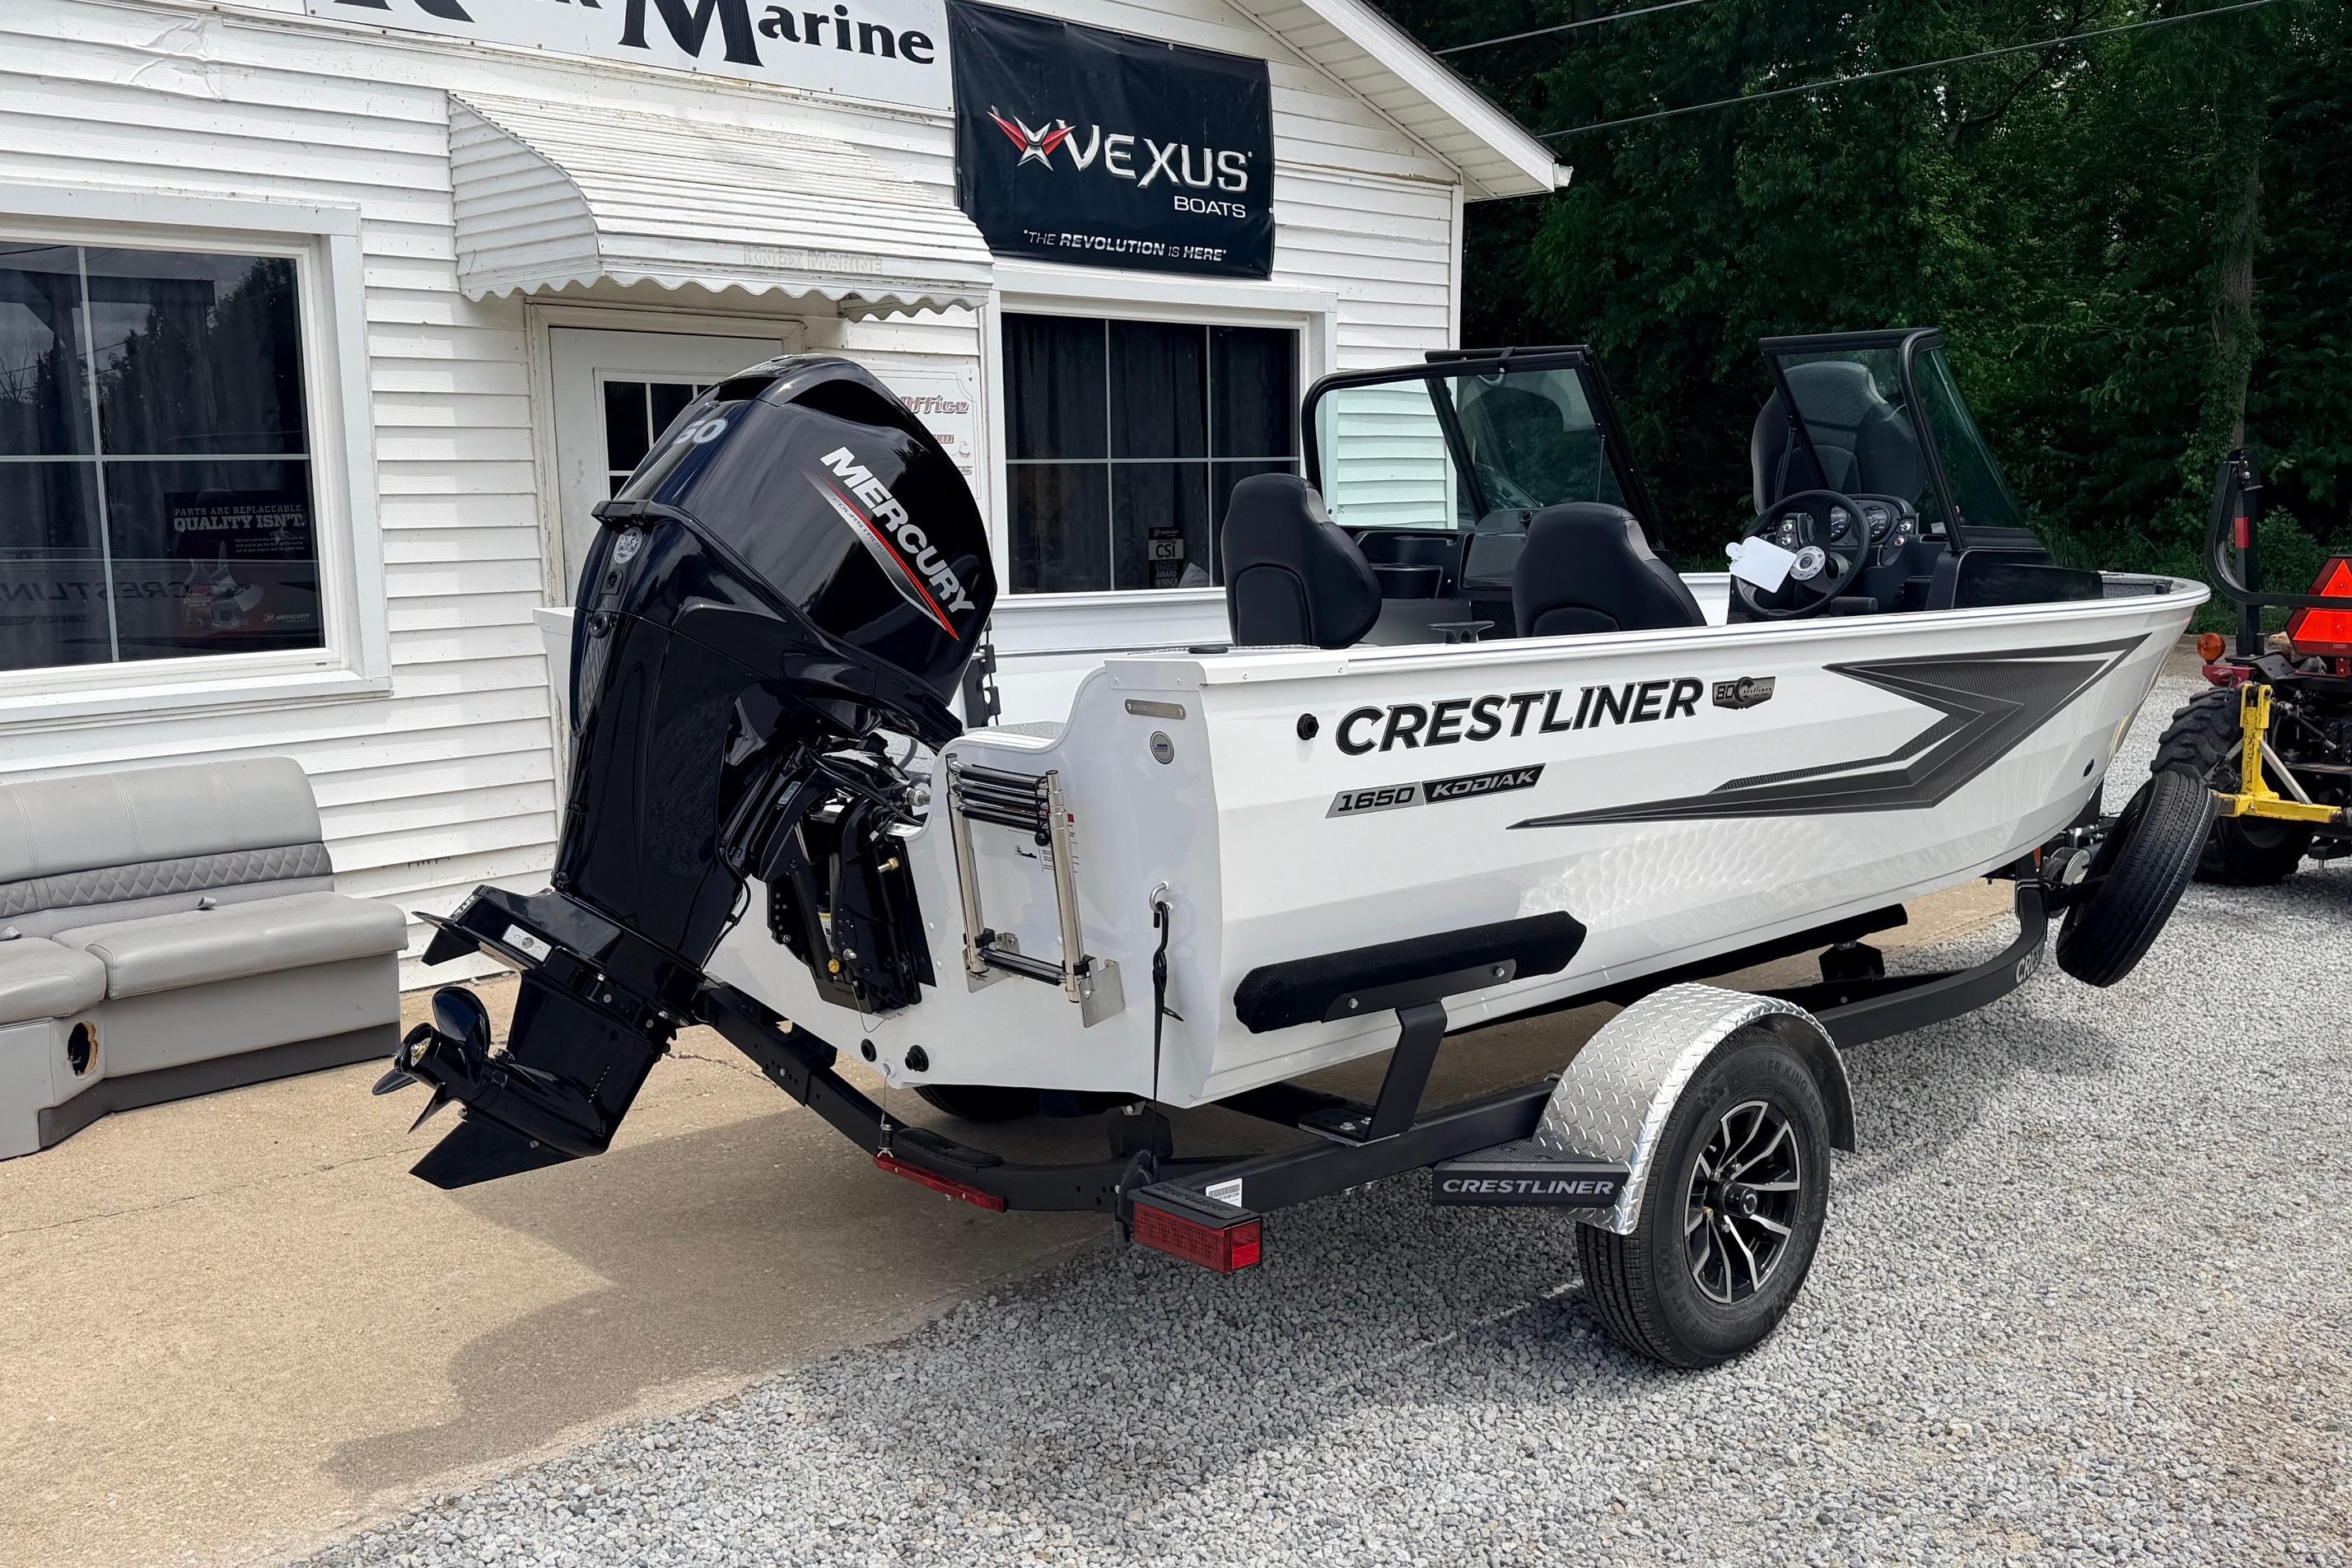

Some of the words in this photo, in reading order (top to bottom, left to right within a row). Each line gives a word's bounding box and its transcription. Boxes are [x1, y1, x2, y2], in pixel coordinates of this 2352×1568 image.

[618, 0, 935, 68] Marine
[1056, 119, 1249, 193] VEXUS
[1174, 196, 1246, 219] BOATS
[1059, 233, 1165, 256] REVOLUTION
[175, 507, 207, 516] PARTS
[211, 506, 230, 515] ARE
[233, 504, 305, 515] REPLACEABLE.
[174, 515, 253, 533] QUALITY
[820, 446, 976, 614] MERCURY
[1715, 683, 1736, 700] 80
[1335, 677, 1704, 756] CRESTLINER
[1337, 785, 1416, 812] 1650
[1431, 770, 1537, 799] KODIAK
[1442, 1178, 1615, 1194] CRESTLINER
